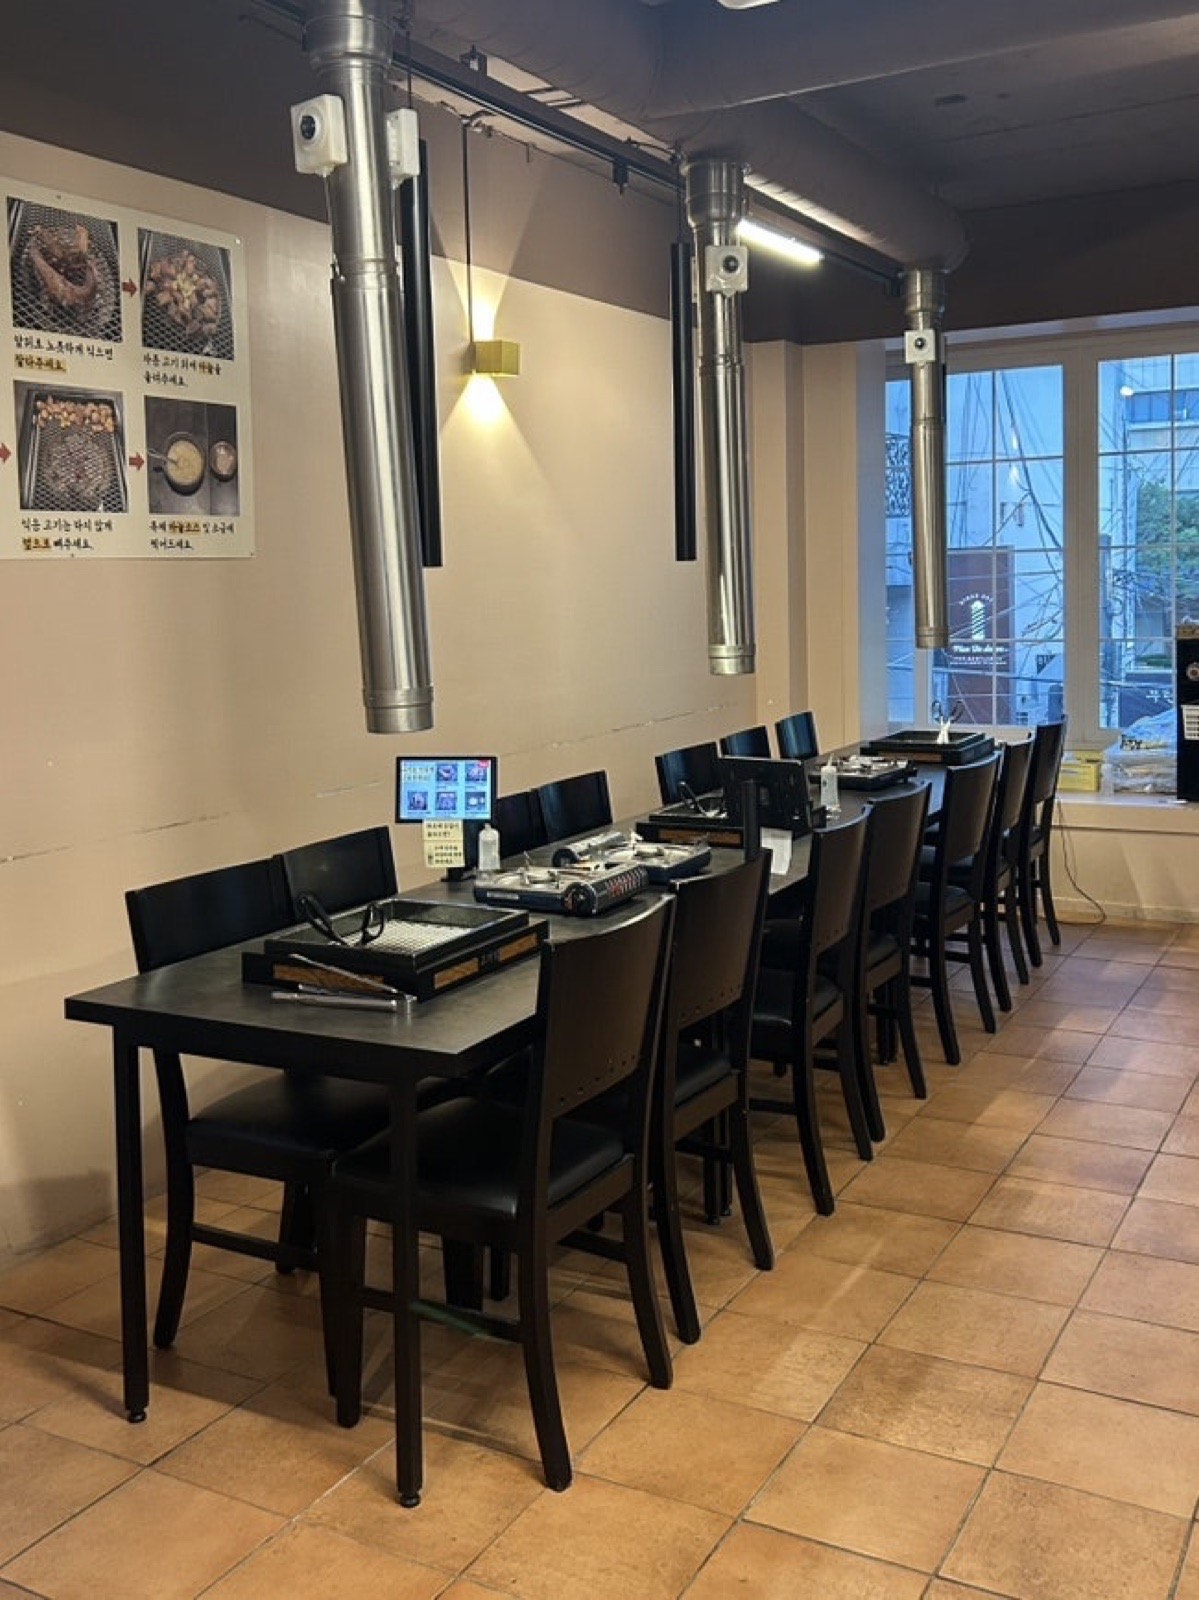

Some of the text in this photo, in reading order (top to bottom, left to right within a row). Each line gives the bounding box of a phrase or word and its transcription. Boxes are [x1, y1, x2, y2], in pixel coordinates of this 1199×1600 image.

[14, 334, 113, 360] 앞뒤로 노릇하게 익으면
[162, 355, 179, 369] 고기
[181, 357, 196, 371] 위에
[198, 361, 222, 375] 마늘을
[21, 517, 41, 532] 익은
[43, 517, 72, 532] 고기는
[94, 518, 113, 532] 않게
[168, 520, 200, 533] 마늘소스
[212, 521, 235, 534] 소금에
[21, 537, 51, 551] 옆으로
